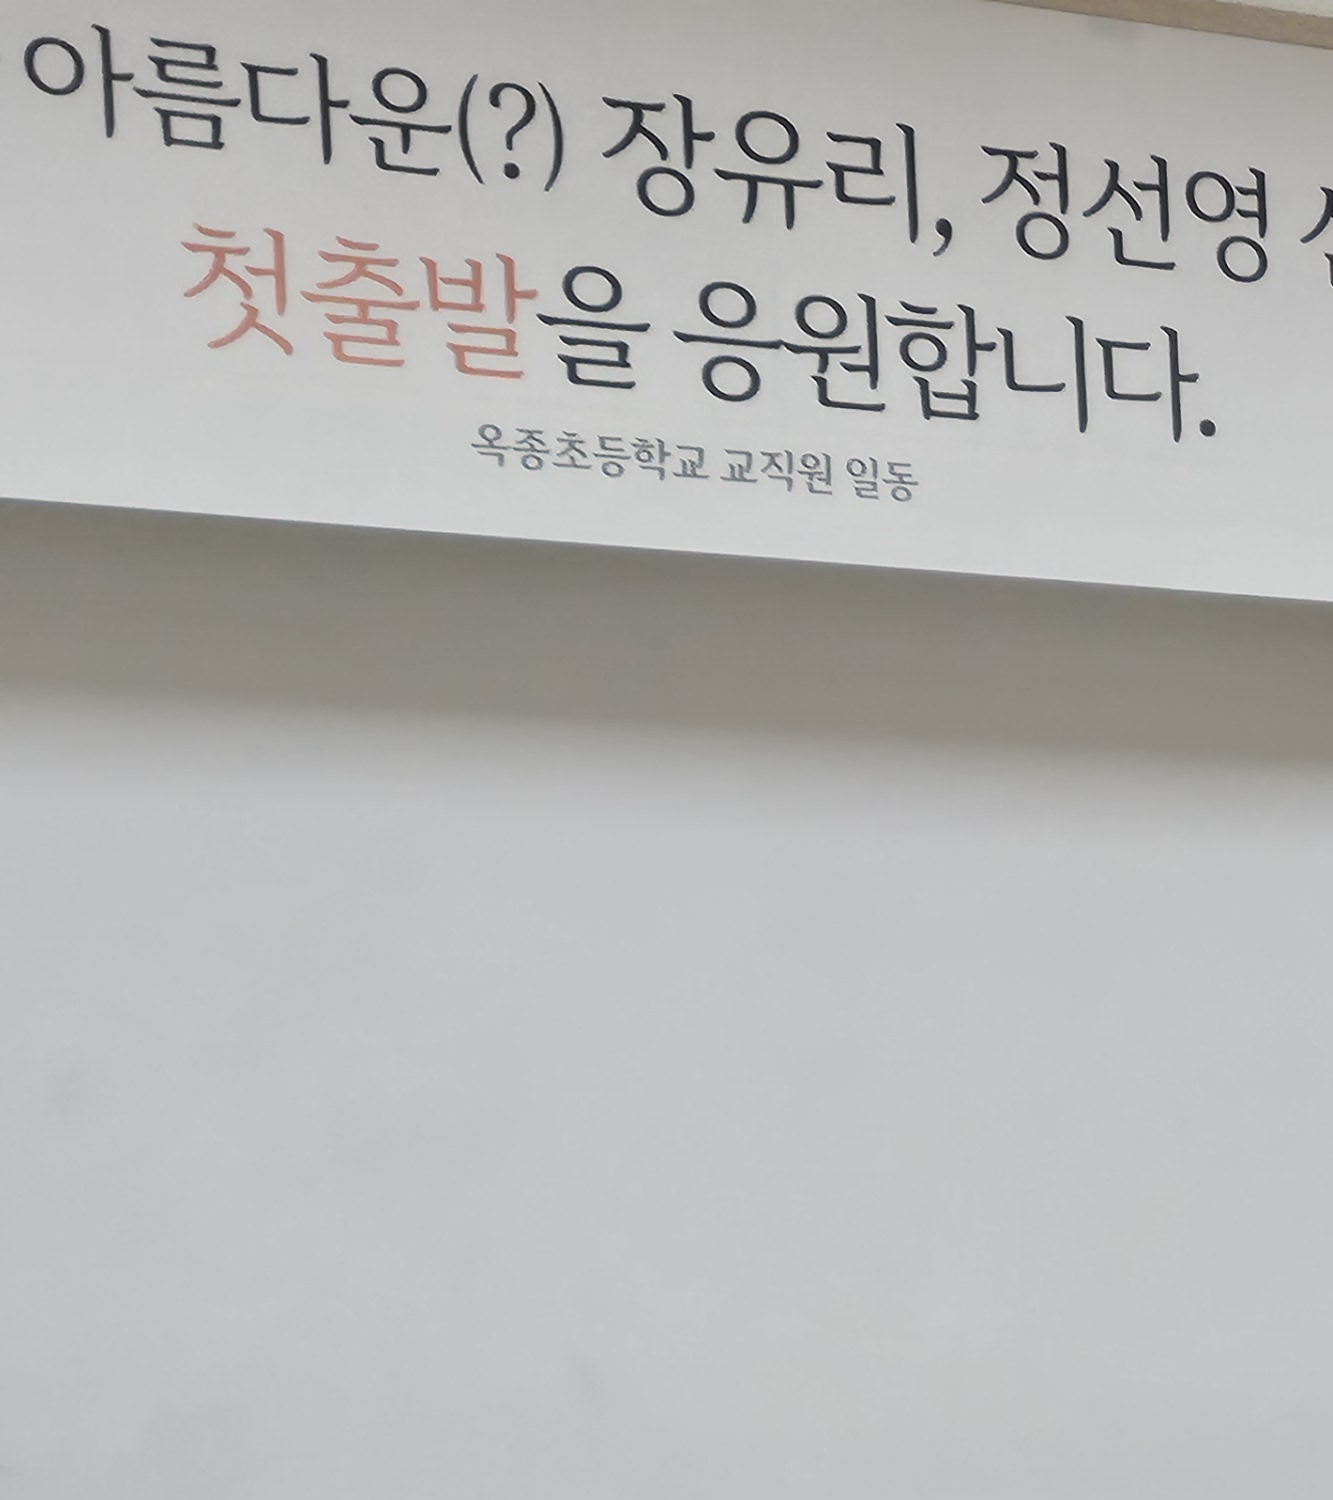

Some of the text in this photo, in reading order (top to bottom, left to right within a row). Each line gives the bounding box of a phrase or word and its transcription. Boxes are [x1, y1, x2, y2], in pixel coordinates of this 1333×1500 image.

[23, 22, 565, 193] 아름다운(?)
[601, 93, 957, 258] 장유리,
[980, 141, 1269, 284] 정선영
[180, 222, 1217, 444] 첫출발을 응원합니다.
[470, 422, 919, 503] 옥종초등학교 교직원 일동
